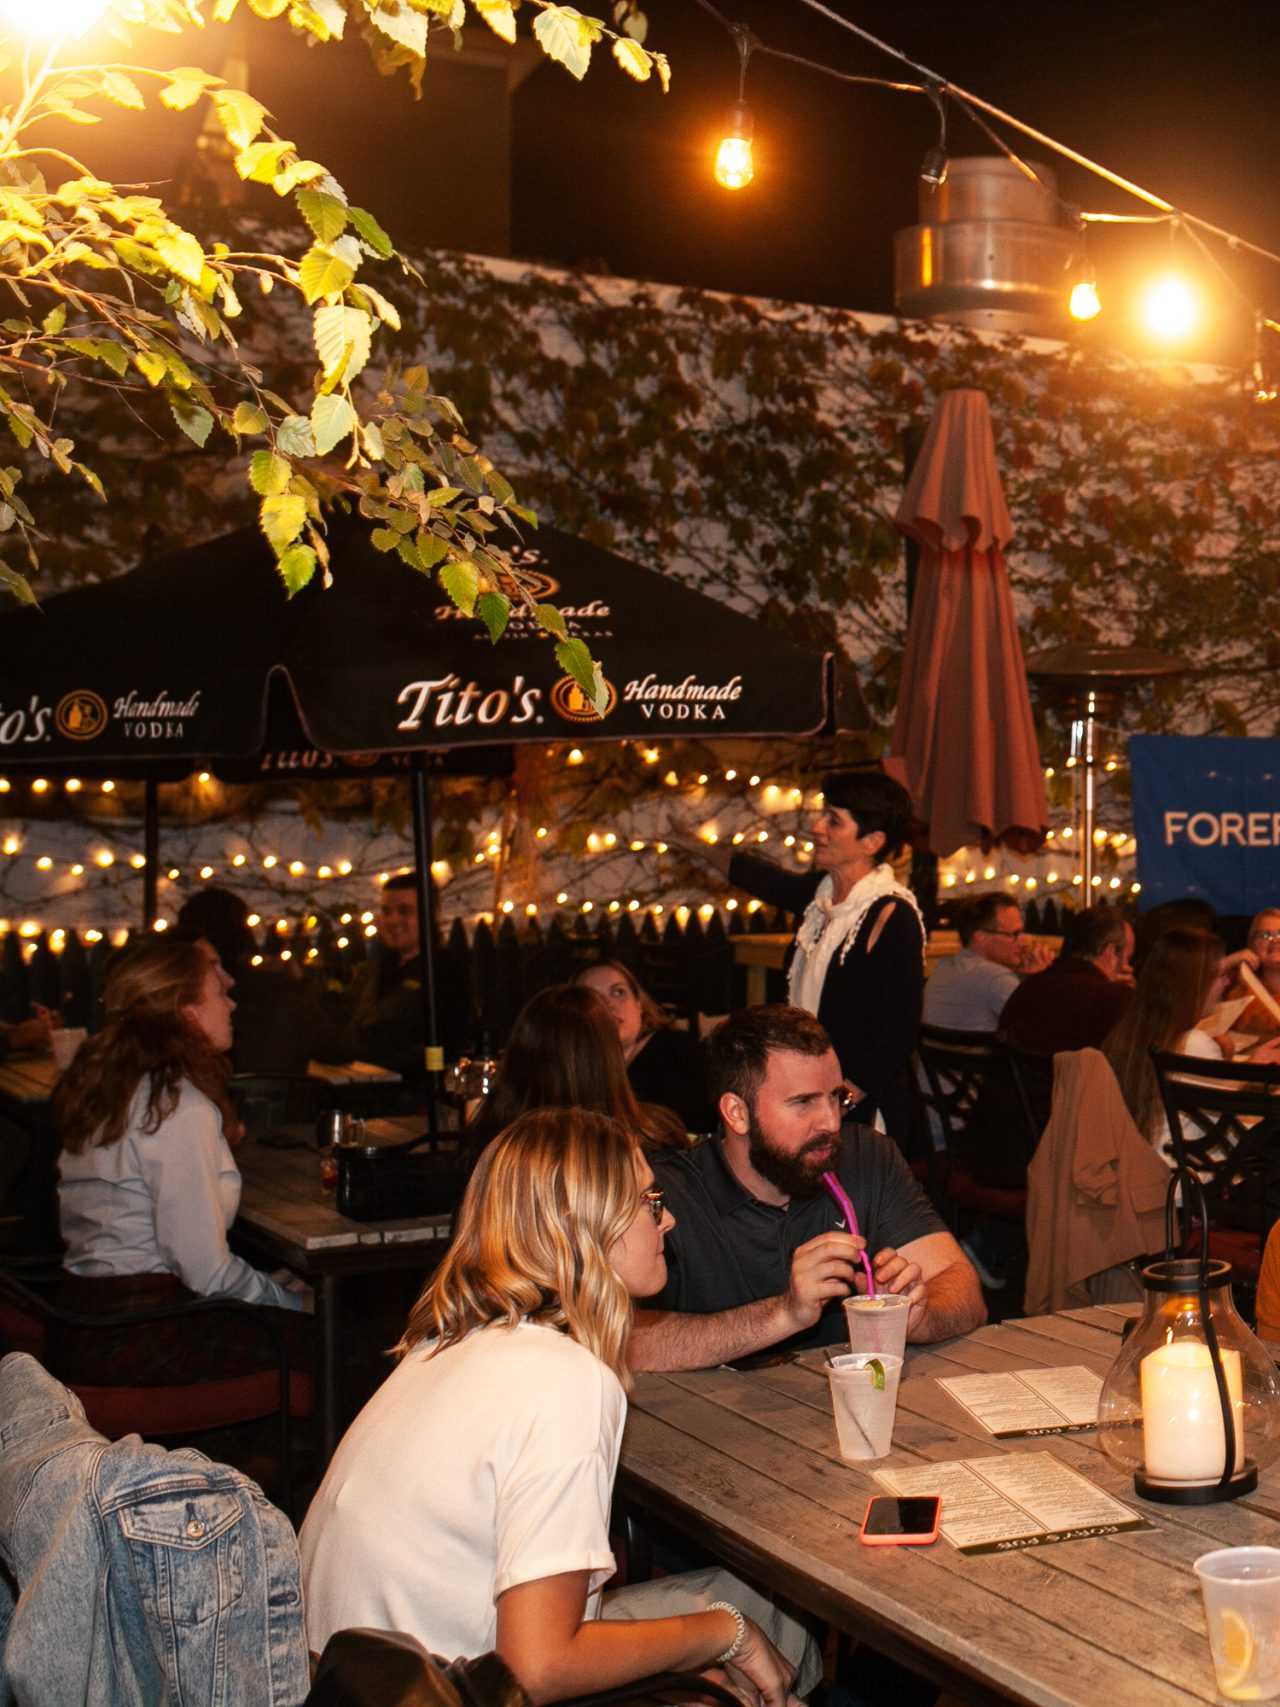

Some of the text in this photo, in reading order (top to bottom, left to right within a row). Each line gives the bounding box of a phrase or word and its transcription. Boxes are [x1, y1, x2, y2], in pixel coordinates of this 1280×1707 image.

[624, 673, 743, 701] Handmade
[0, 695, 52, 745] o's.
[640, 703, 727, 720] VODKA
[124, 721, 184, 738] VODKA
